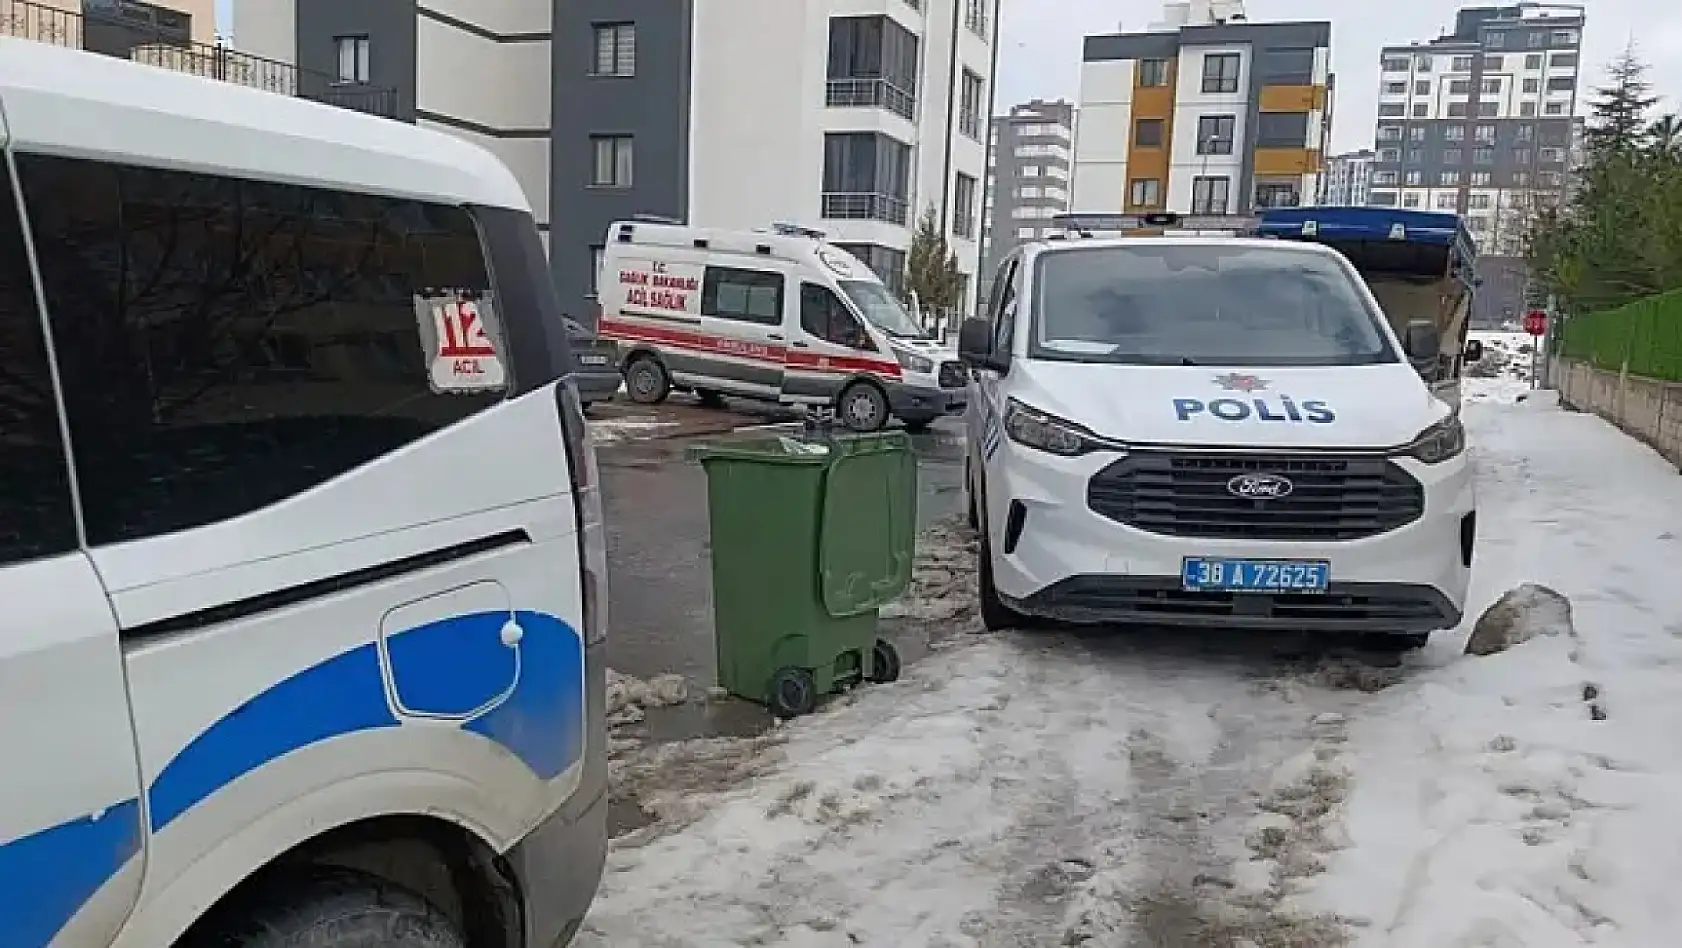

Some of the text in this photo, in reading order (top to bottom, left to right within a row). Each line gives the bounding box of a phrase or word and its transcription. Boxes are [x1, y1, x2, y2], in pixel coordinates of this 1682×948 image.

[1173, 393, 1336, 423] POLİS
[1239, 478, 1281, 496] Ford
[1232, 563, 1244, 587] A
[1254, 564, 1319, 588] 72625
